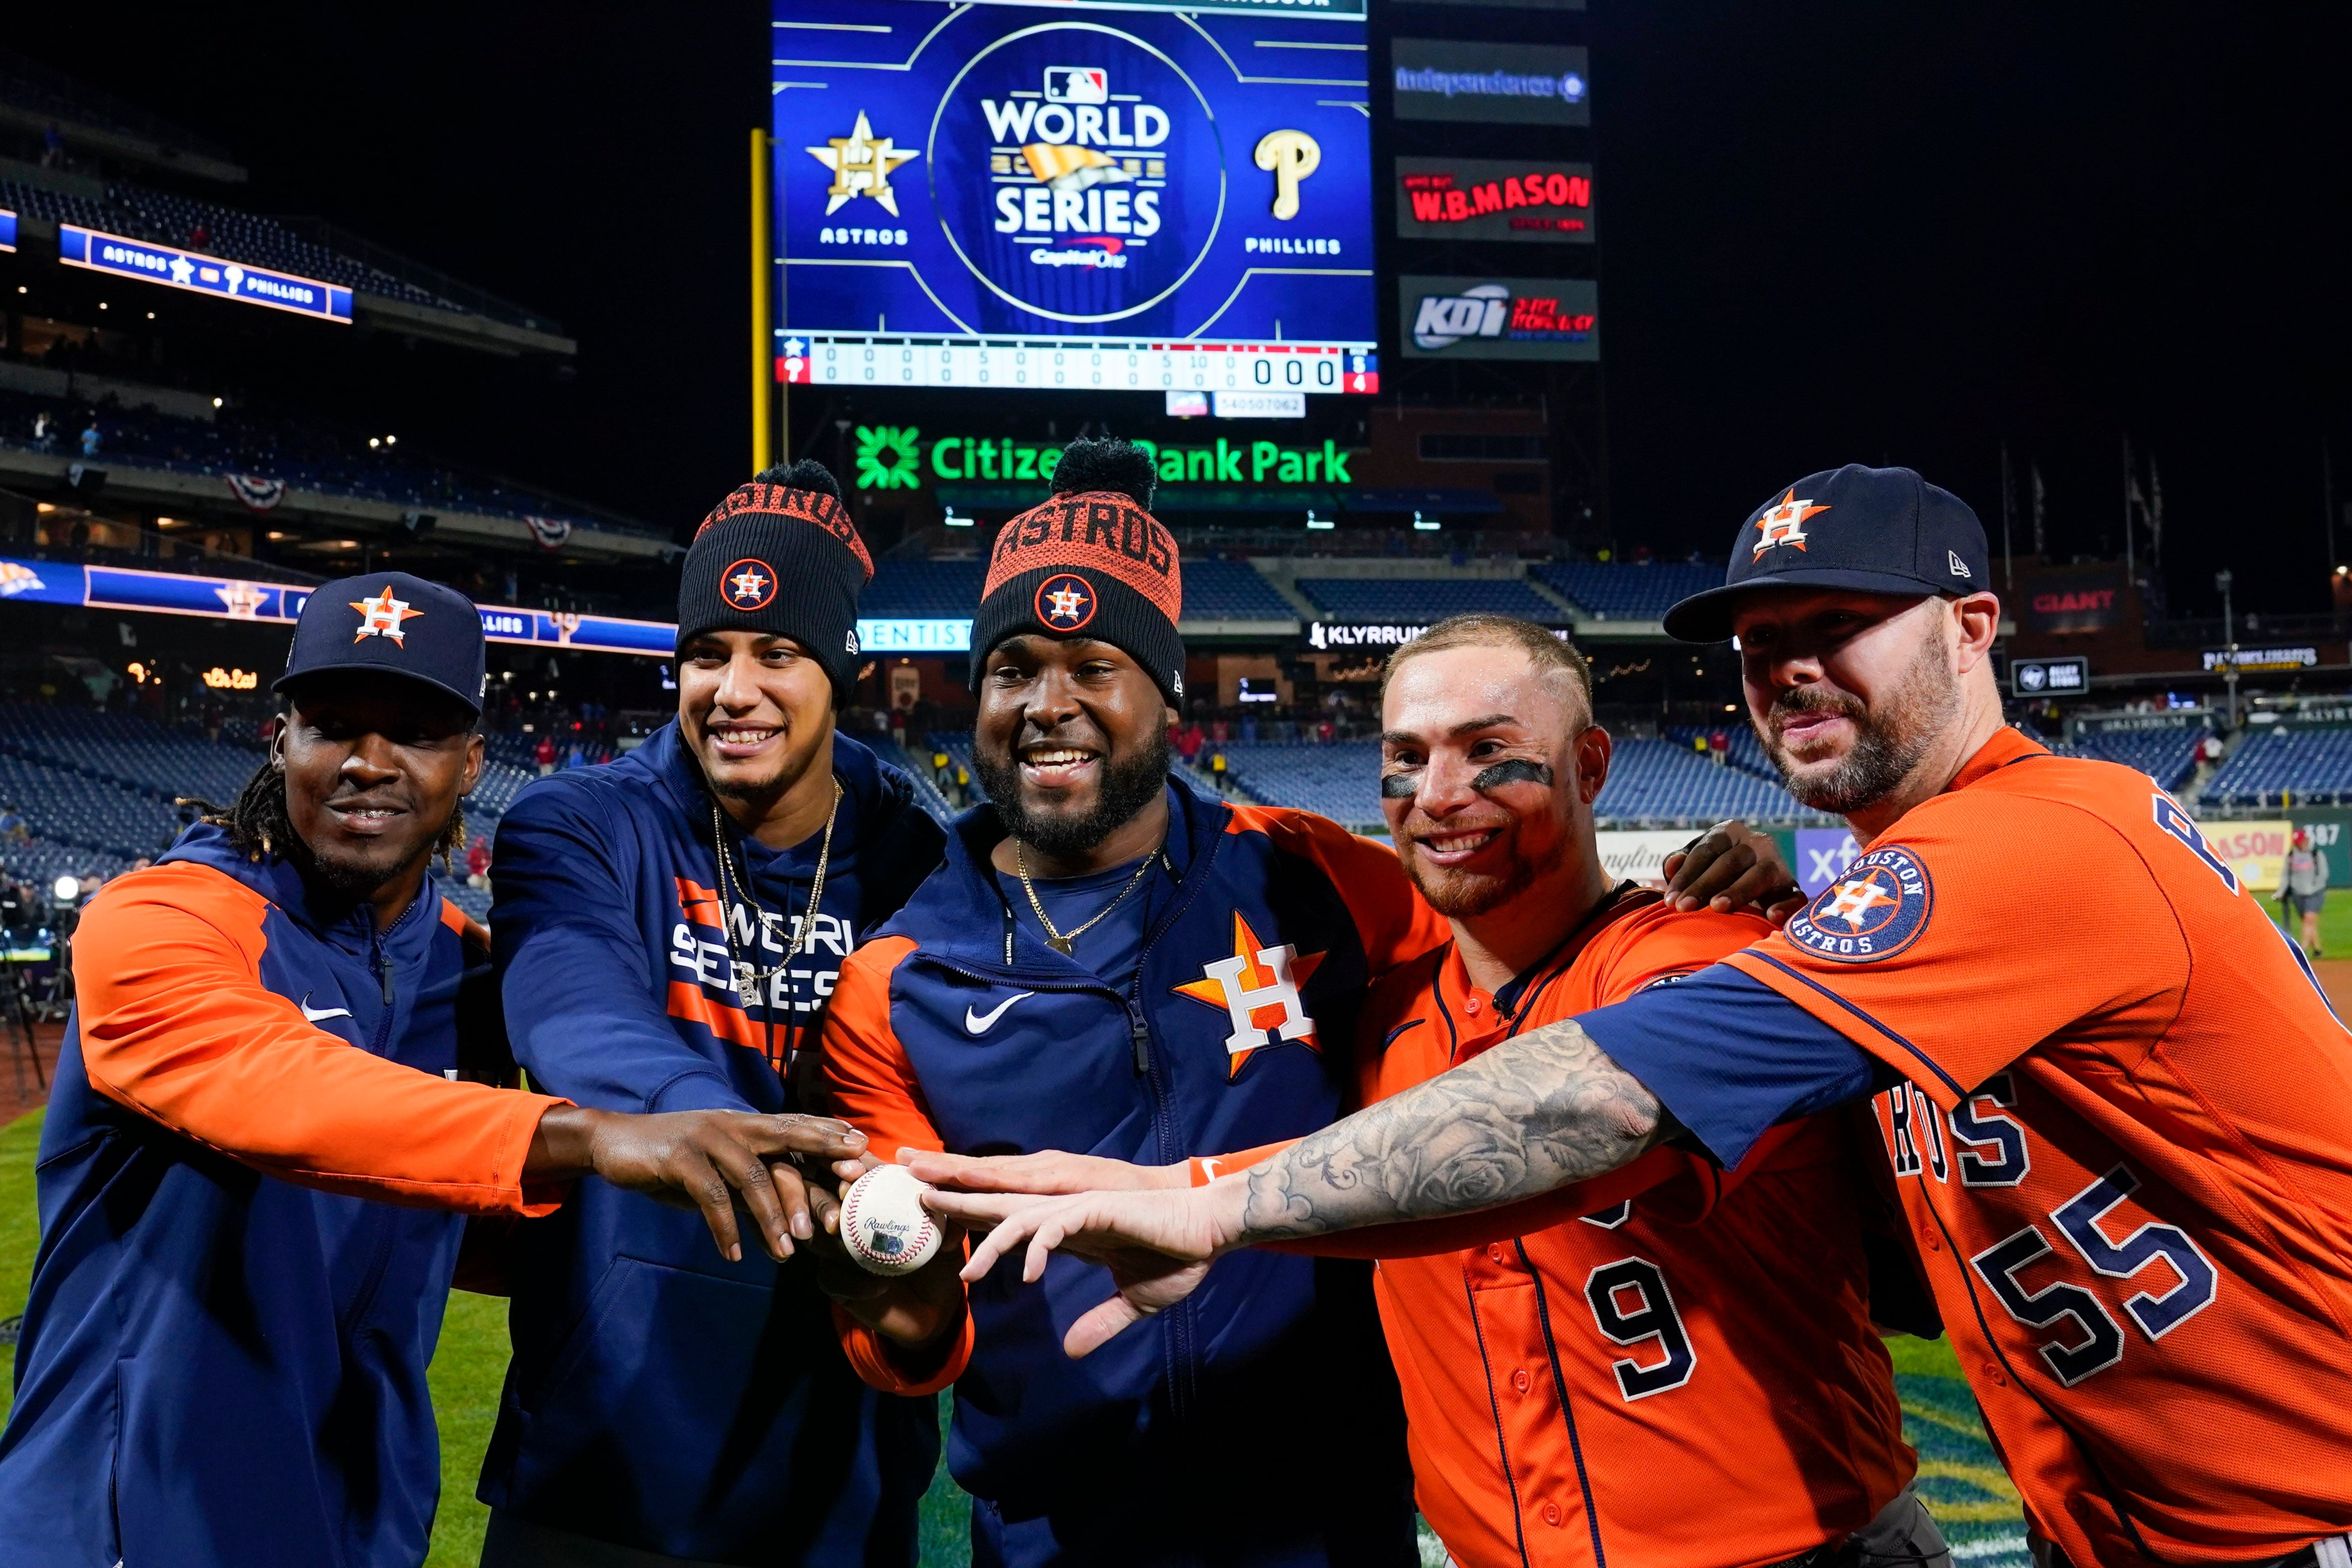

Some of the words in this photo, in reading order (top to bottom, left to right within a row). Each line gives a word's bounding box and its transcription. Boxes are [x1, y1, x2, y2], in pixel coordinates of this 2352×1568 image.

[981, 99, 1170, 147] WORLD
[995, 187, 1161, 237] SERIES
[820, 228, 908, 245] ASTROS
[1245, 237, 1341, 255] PHILLIES
[103, 246, 167, 272] ASTROS
[247, 277, 313, 303] PHILLIES
[827, 348, 836, 361] 0
[865, 349, 874, 361] 0
[904, 349, 912, 362] 0
[942, 350, 950, 363] 0
[980, 351, 988, 364] 5
[1017, 352, 1025, 365] 0
[1055, 352, 1064, 365] 0
[1092, 355, 1100, 367] 0
[1129, 355, 1137, 367] 0
[1164, 355, 1171, 368] 5
[1191, 356, 1207, 368] 10
[1227, 356, 1234, 369] 0
[1256, 360, 1270, 385] 0
[1287, 361, 1302, 385] 0
[1319, 362, 1333, 385] 0
[827, 367, 836, 379] 0
[865, 367, 874, 380] 0
[904, 368, 912, 381] 0
[942, 369, 950, 381] 0
[980, 370, 988, 382] 0
[1017, 370, 1025, 383] 0
[1055, 371, 1064, 383] 0
[1092, 372, 1100, 385] 0
[1129, 373, 1137, 385] 0
[1164, 374, 1171, 386] 0
[1195, 374, 1204, 386] 0
[1227, 374, 1234, 387] 0
[932, 437, 1064, 481] Citize
[1253, 439, 1352, 483] Park
[996, 501, 1170, 577] ASTROS
[2218, 831, 2285, 858] ASON
[1792, 918, 1872, 953] ASTROS
[1888, 1070, 2031, 1187] ROS
[864, 1217, 910, 1236] Rawlings
[1969, 1162, 2219, 1388] 55
[1584, 1255, 1697, 1402] 9
